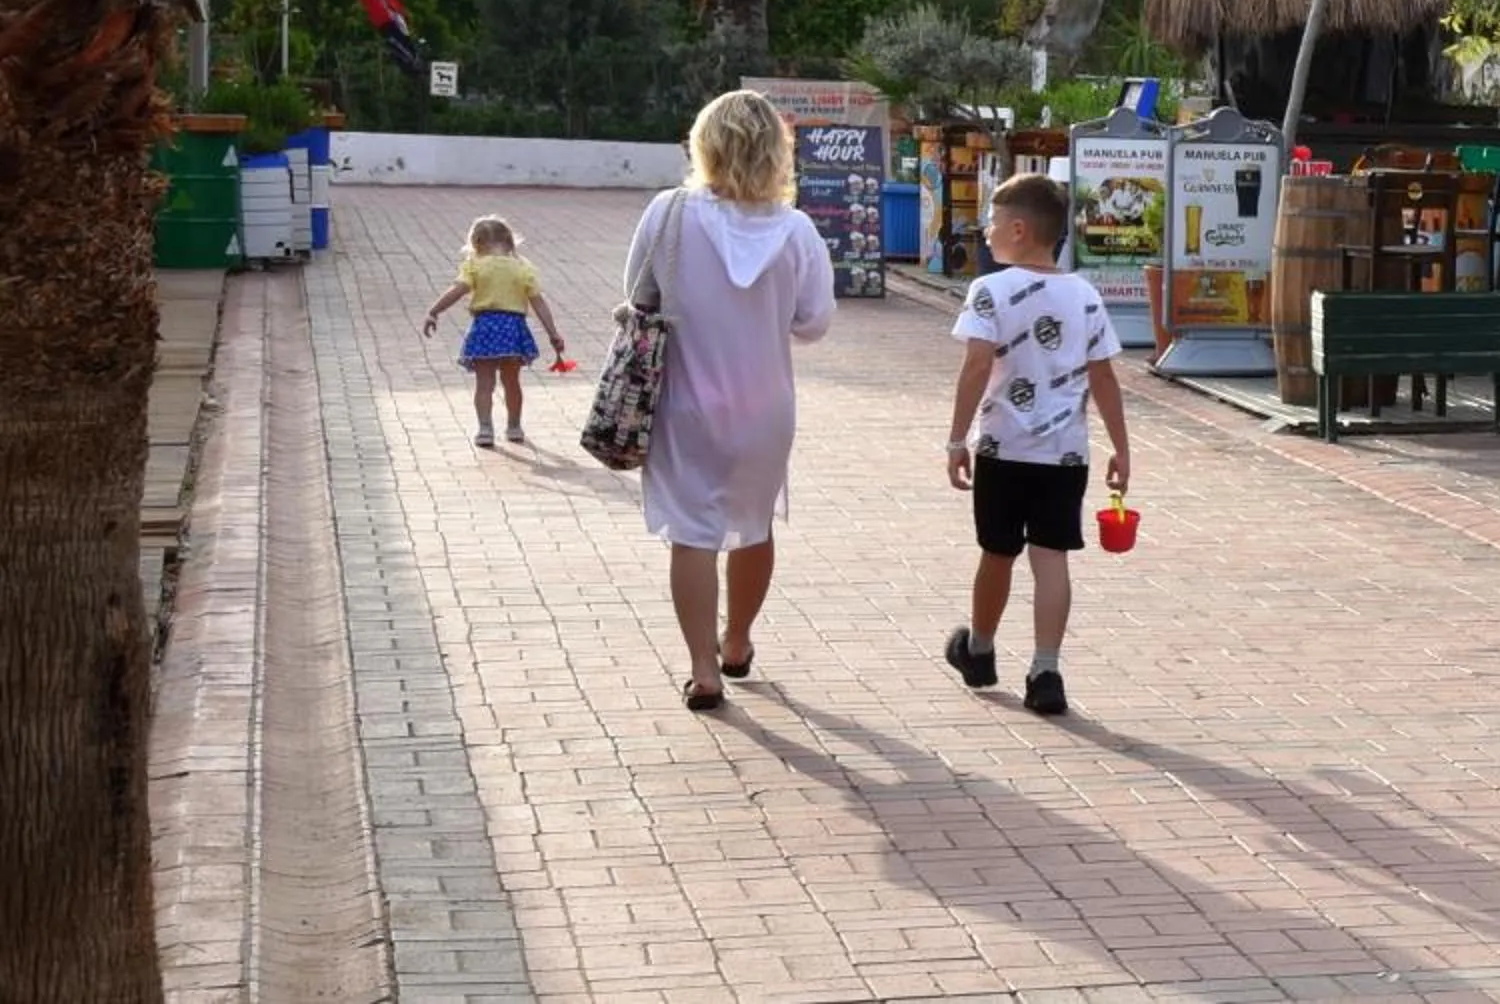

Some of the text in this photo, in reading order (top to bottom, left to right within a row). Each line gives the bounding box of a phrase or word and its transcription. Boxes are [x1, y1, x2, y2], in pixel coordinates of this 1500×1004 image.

[806, 128, 867, 145] HAPPY
[812, 144, 865, 162] HOUR
[1083, 149, 1163, 159] MANUELA PUB
[1184, 150, 1267, 162] MANUELA PUB
